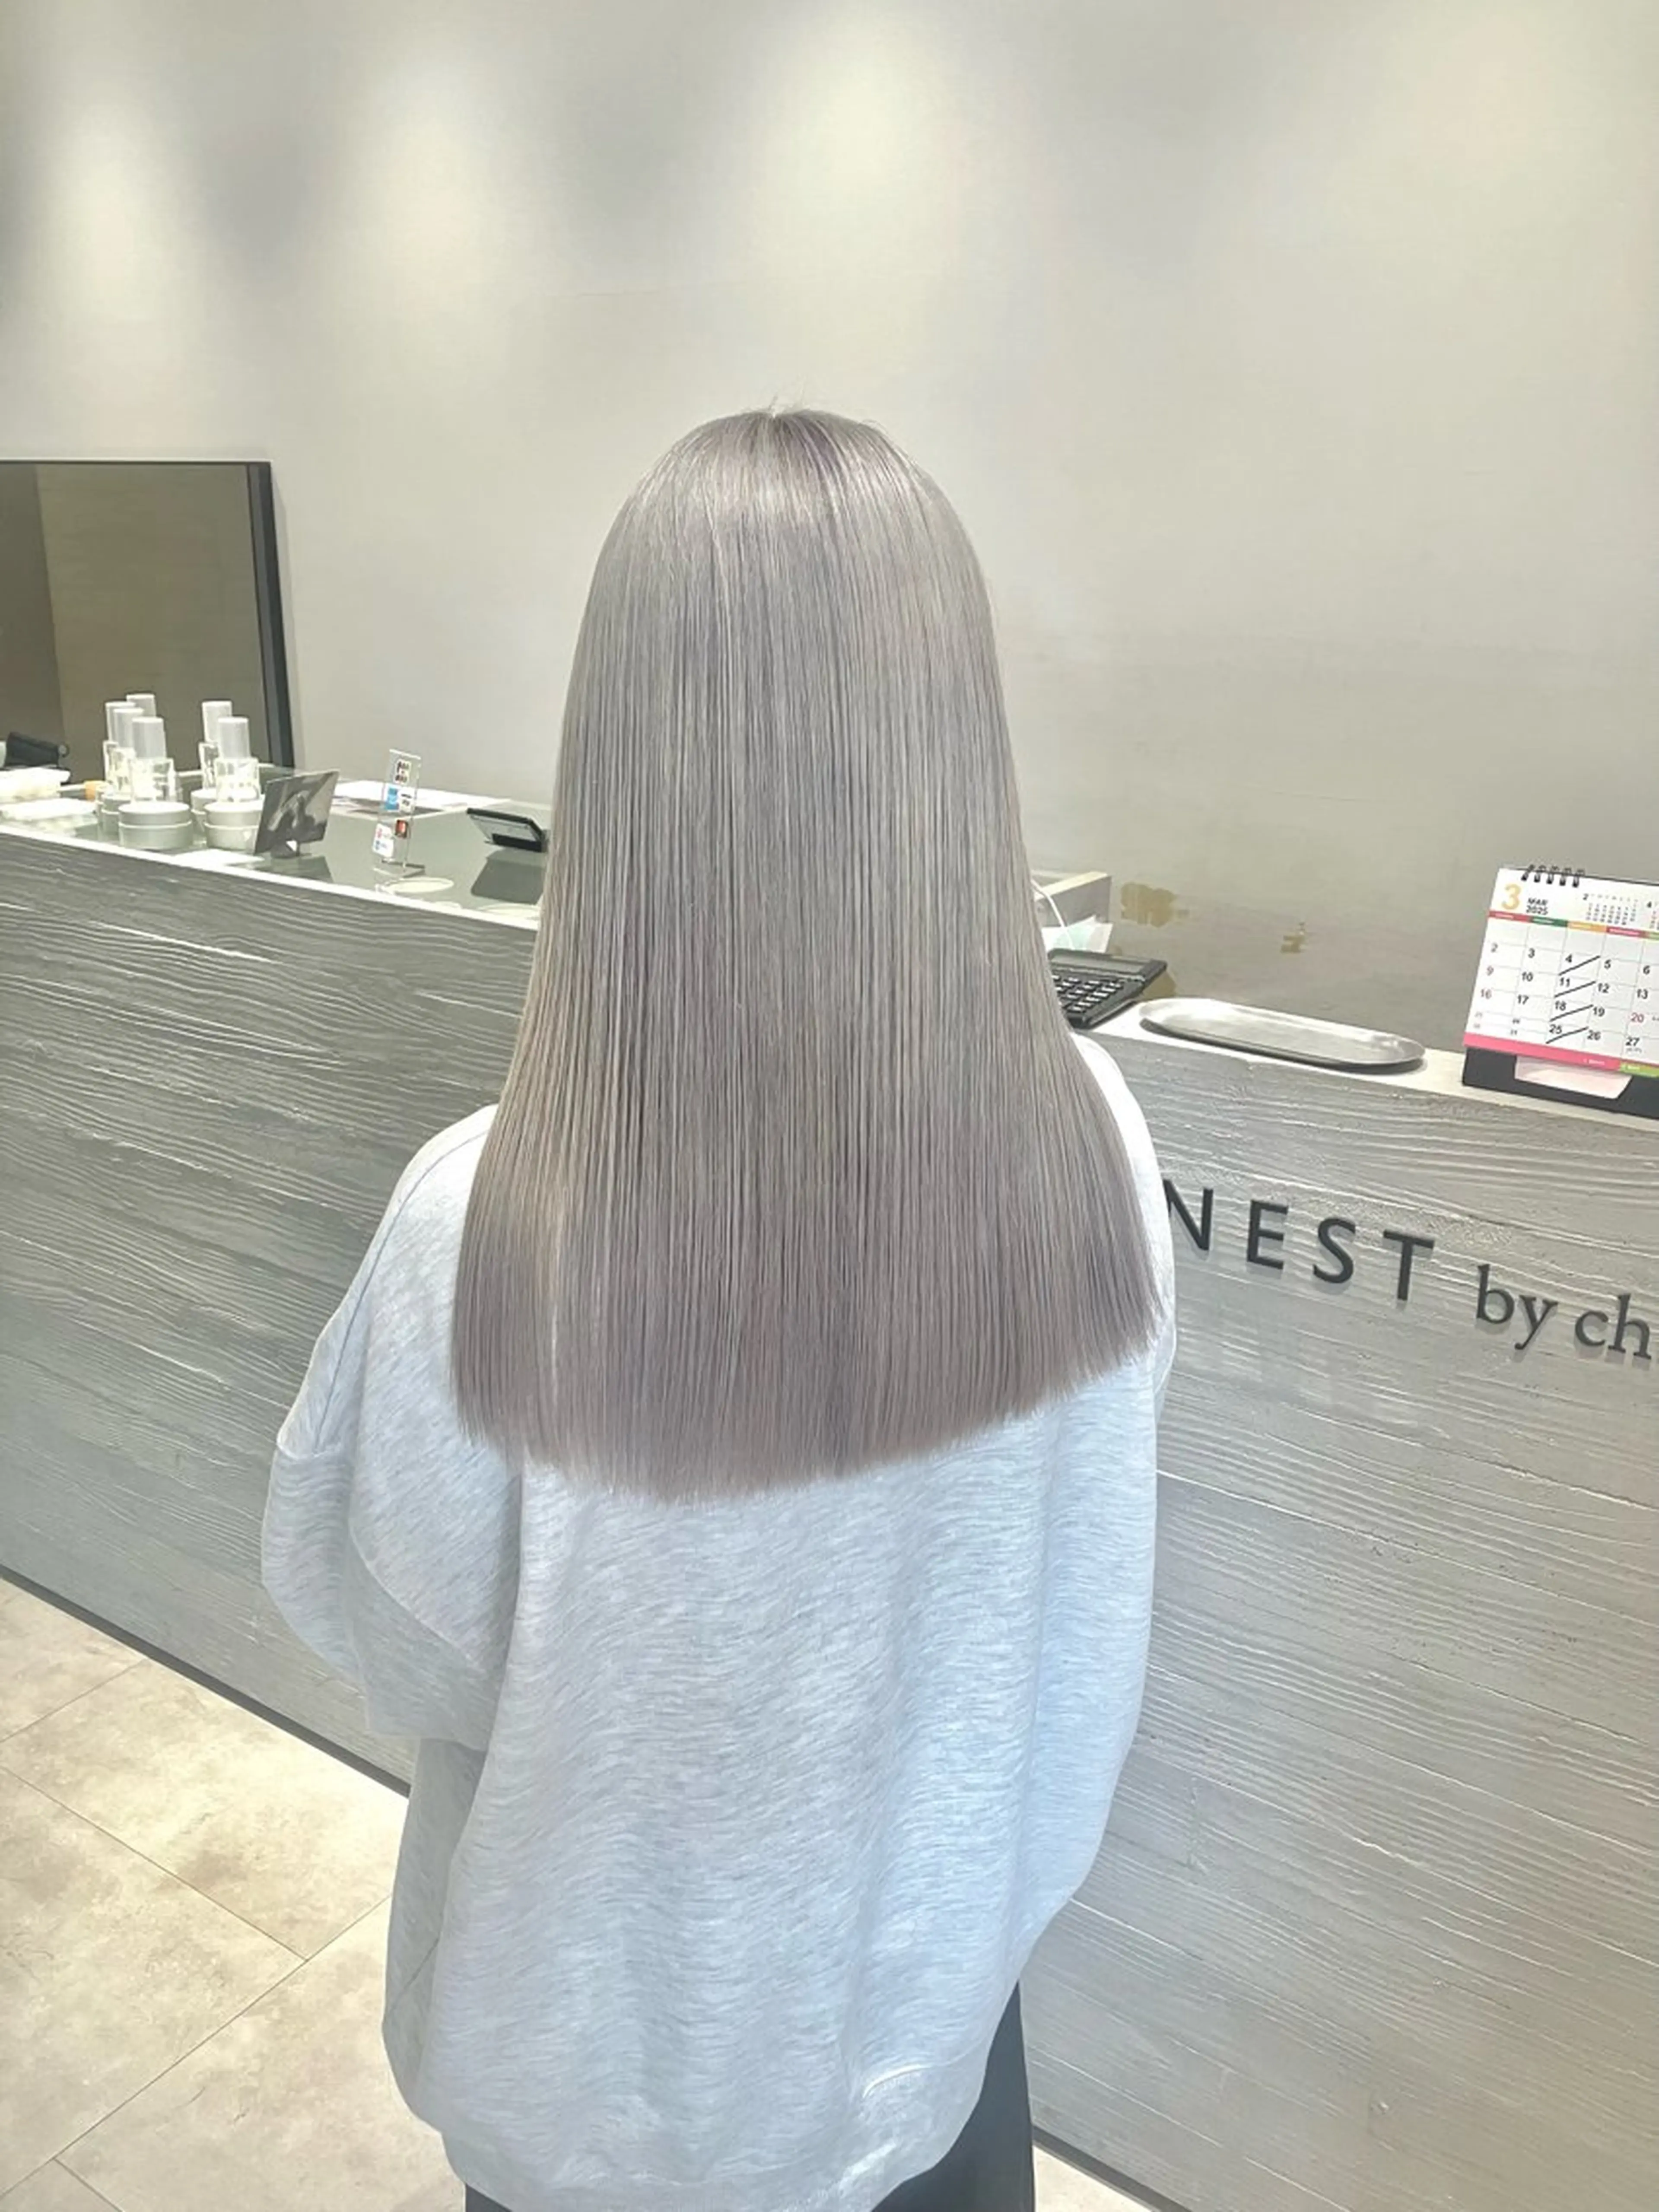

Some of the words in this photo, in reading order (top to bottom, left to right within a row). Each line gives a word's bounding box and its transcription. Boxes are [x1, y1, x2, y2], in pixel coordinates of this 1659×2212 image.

[1502, 883, 1521, 910] 3
[1527, 897, 1548, 906] MAR
[1491, 942, 1498, 953] 2
[1528, 948, 1535, 958] 3
[1565, 953, 1572, 963] 4
[1604, 959, 1611, 969] 5
[1643, 965, 1650, 975] 6
[1486, 965, 1494, 976] 9
[1521, 971, 1534, 982] 10
[1559, 977, 1570, 988] 11
[1598, 982, 1610, 994] 12
[1637, 988, 1649, 1000] 13
[1480, 988, 1492, 1000] 16
[1517, 994, 1529, 1005] 17
[1555, 1000, 1567, 1011] 18
[1592, 1006, 1605, 1017] 19
[1630, 1012, 1645, 1023] 20
[1549, 1023, 1563, 1035] 25
[1587, 1029, 1601, 1041] 26
[1625, 1036, 1640, 1046] 27
[1163, 1179, 1435, 1301] NEST
[1477, 1264, 1559, 1350] by
[1575, 1293, 1652, 1360] ch
